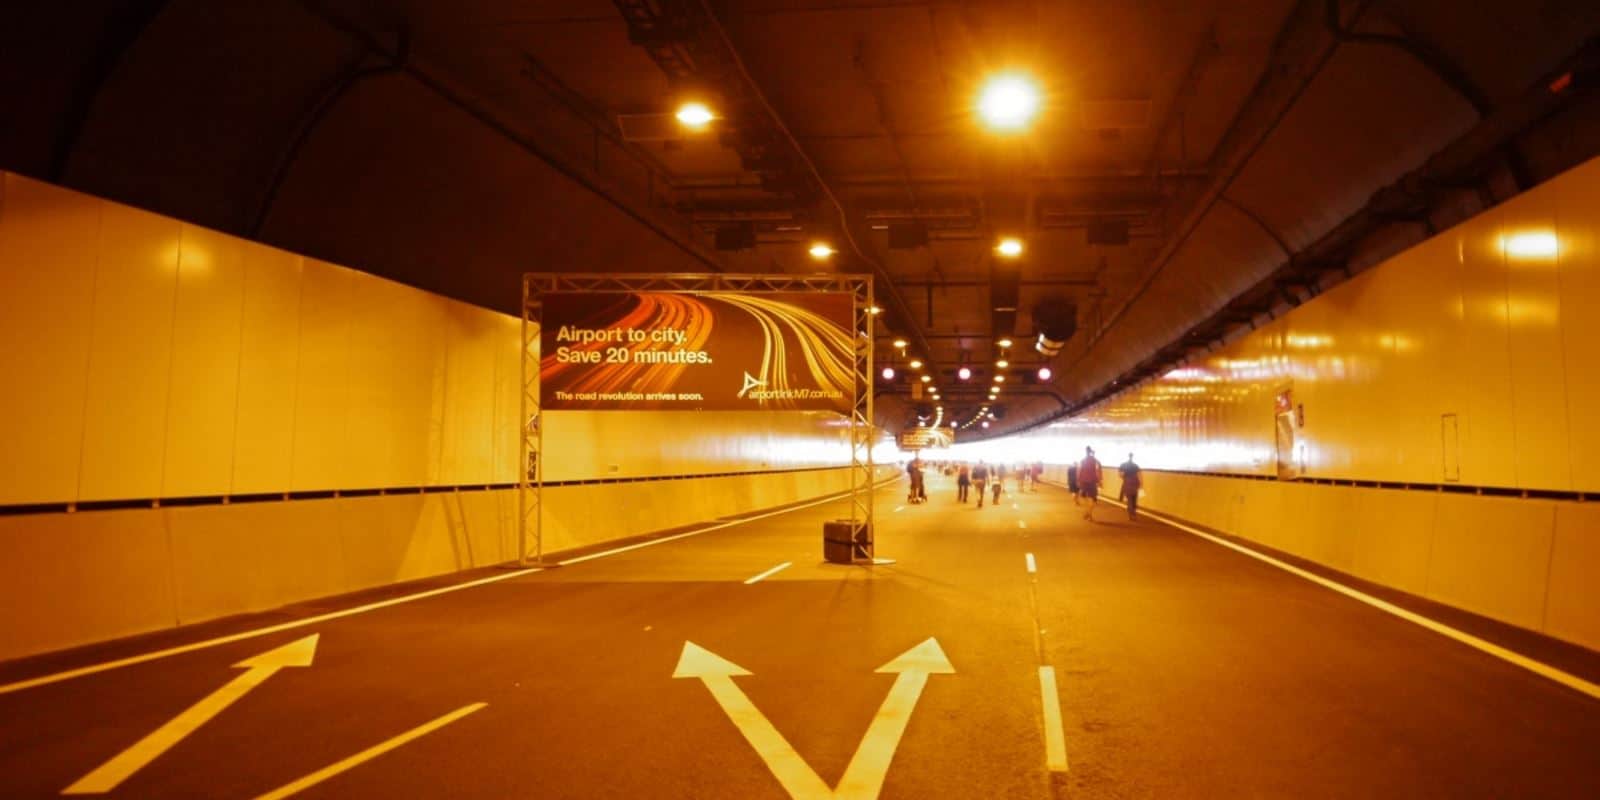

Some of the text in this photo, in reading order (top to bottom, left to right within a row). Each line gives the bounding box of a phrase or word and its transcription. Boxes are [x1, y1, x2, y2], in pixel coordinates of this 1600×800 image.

[556, 325, 688, 345] Airport to city.
[556, 346, 713, 364] Save 20 minutes.
[556, 391, 704, 400] The road revolution arrives soon.
